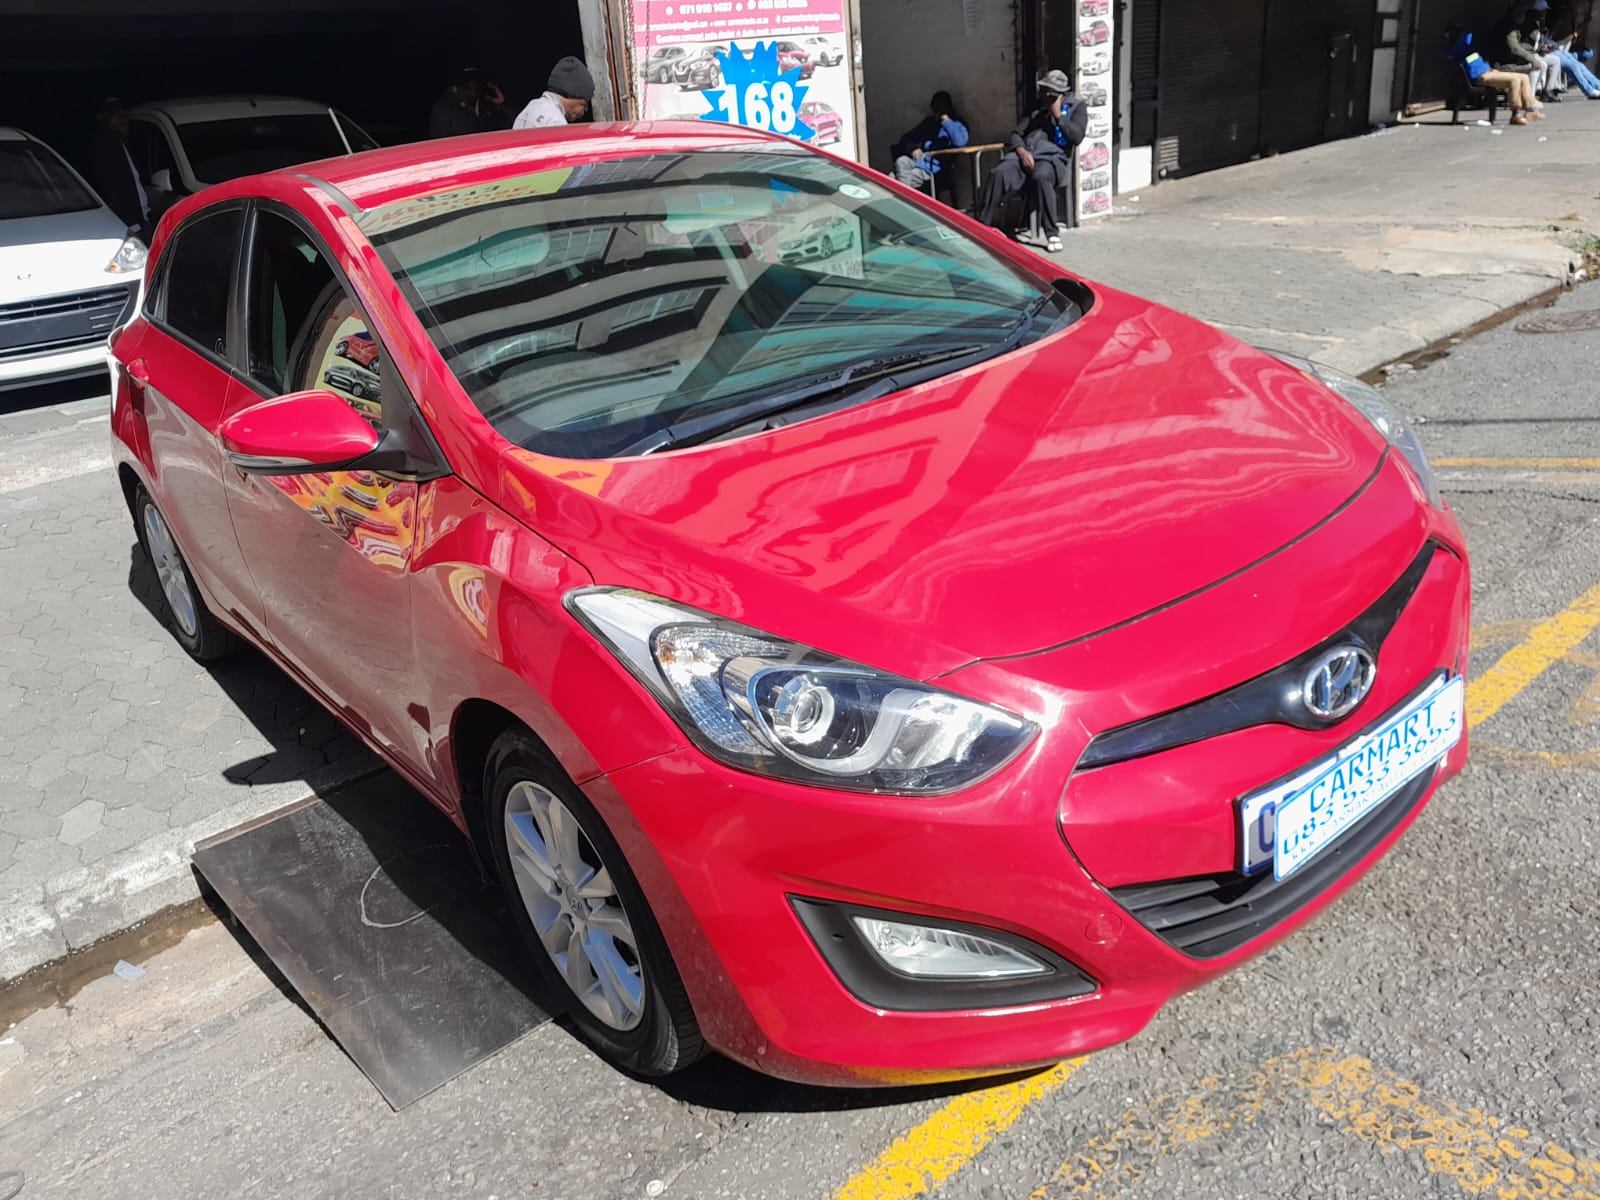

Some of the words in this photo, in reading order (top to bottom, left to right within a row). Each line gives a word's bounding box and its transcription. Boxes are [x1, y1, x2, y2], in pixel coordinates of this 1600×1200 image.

[717, 81, 796, 133] 168
[1283, 802, 1334, 855] 083
[1343, 760, 1390, 808] 533
[1398, 711, 1456, 766] 3653
[1310, 700, 1436, 813] CARMART
